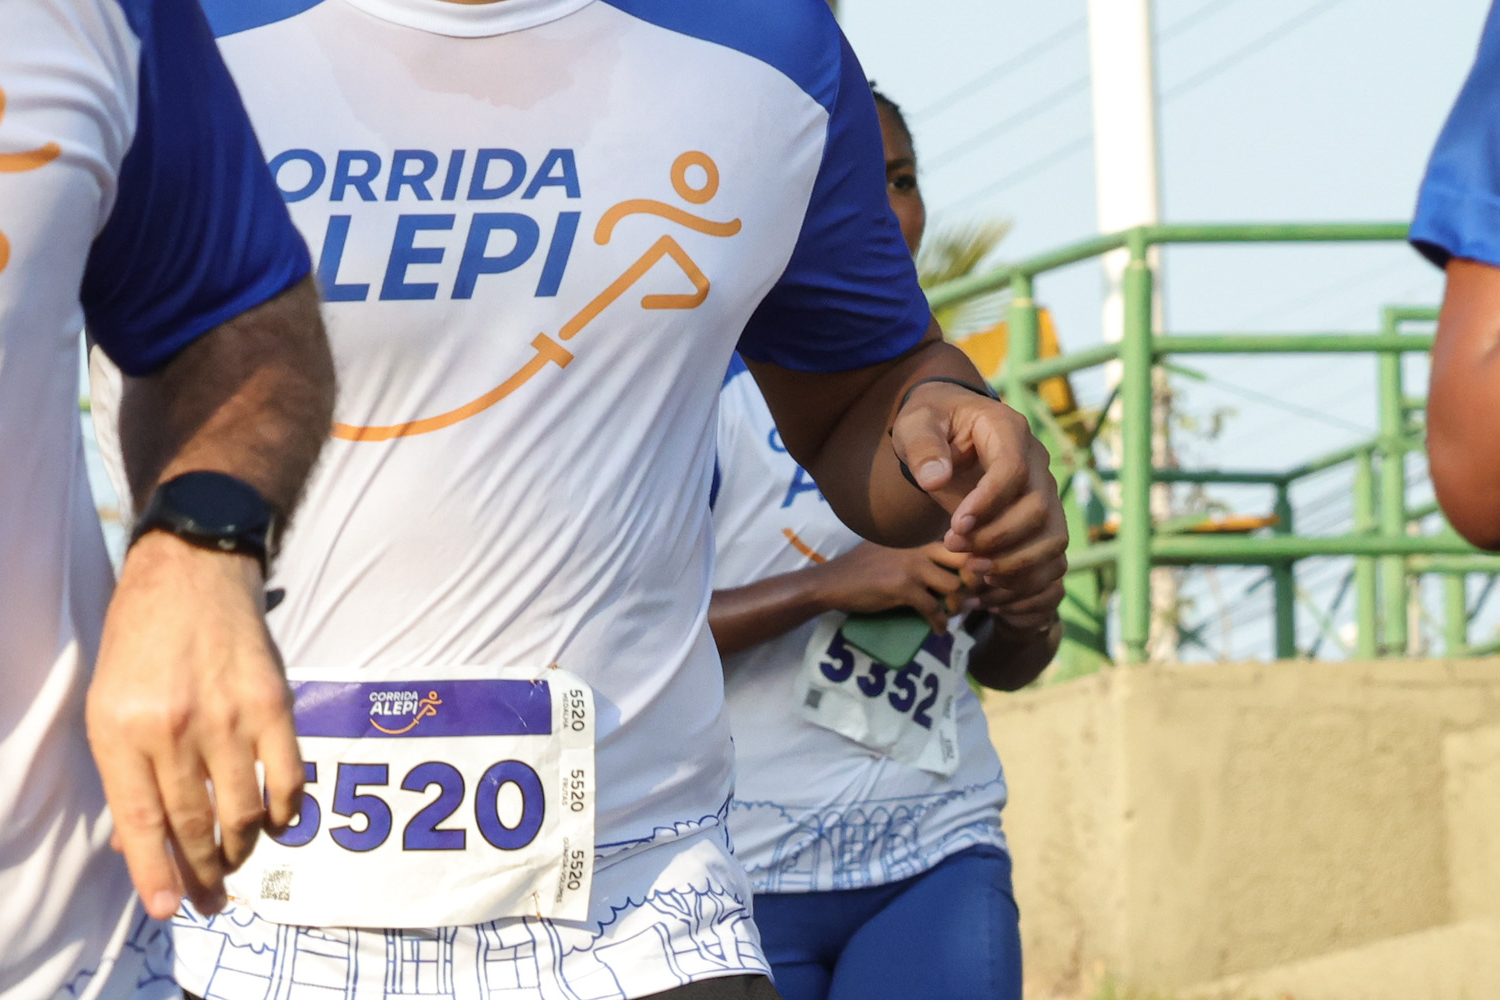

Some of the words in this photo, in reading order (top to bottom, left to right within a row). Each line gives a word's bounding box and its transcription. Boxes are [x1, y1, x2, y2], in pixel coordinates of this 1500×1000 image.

[268, 148, 582, 203] ORRIDA
[316, 211, 582, 303] LEPI
[369, 691, 418, 702] CORRIDA
[369, 701, 418, 715] ALEPI
[570, 689, 585, 731] 5520
[571, 769, 584, 812] 5520
[567, 850, 584, 890] 5520
